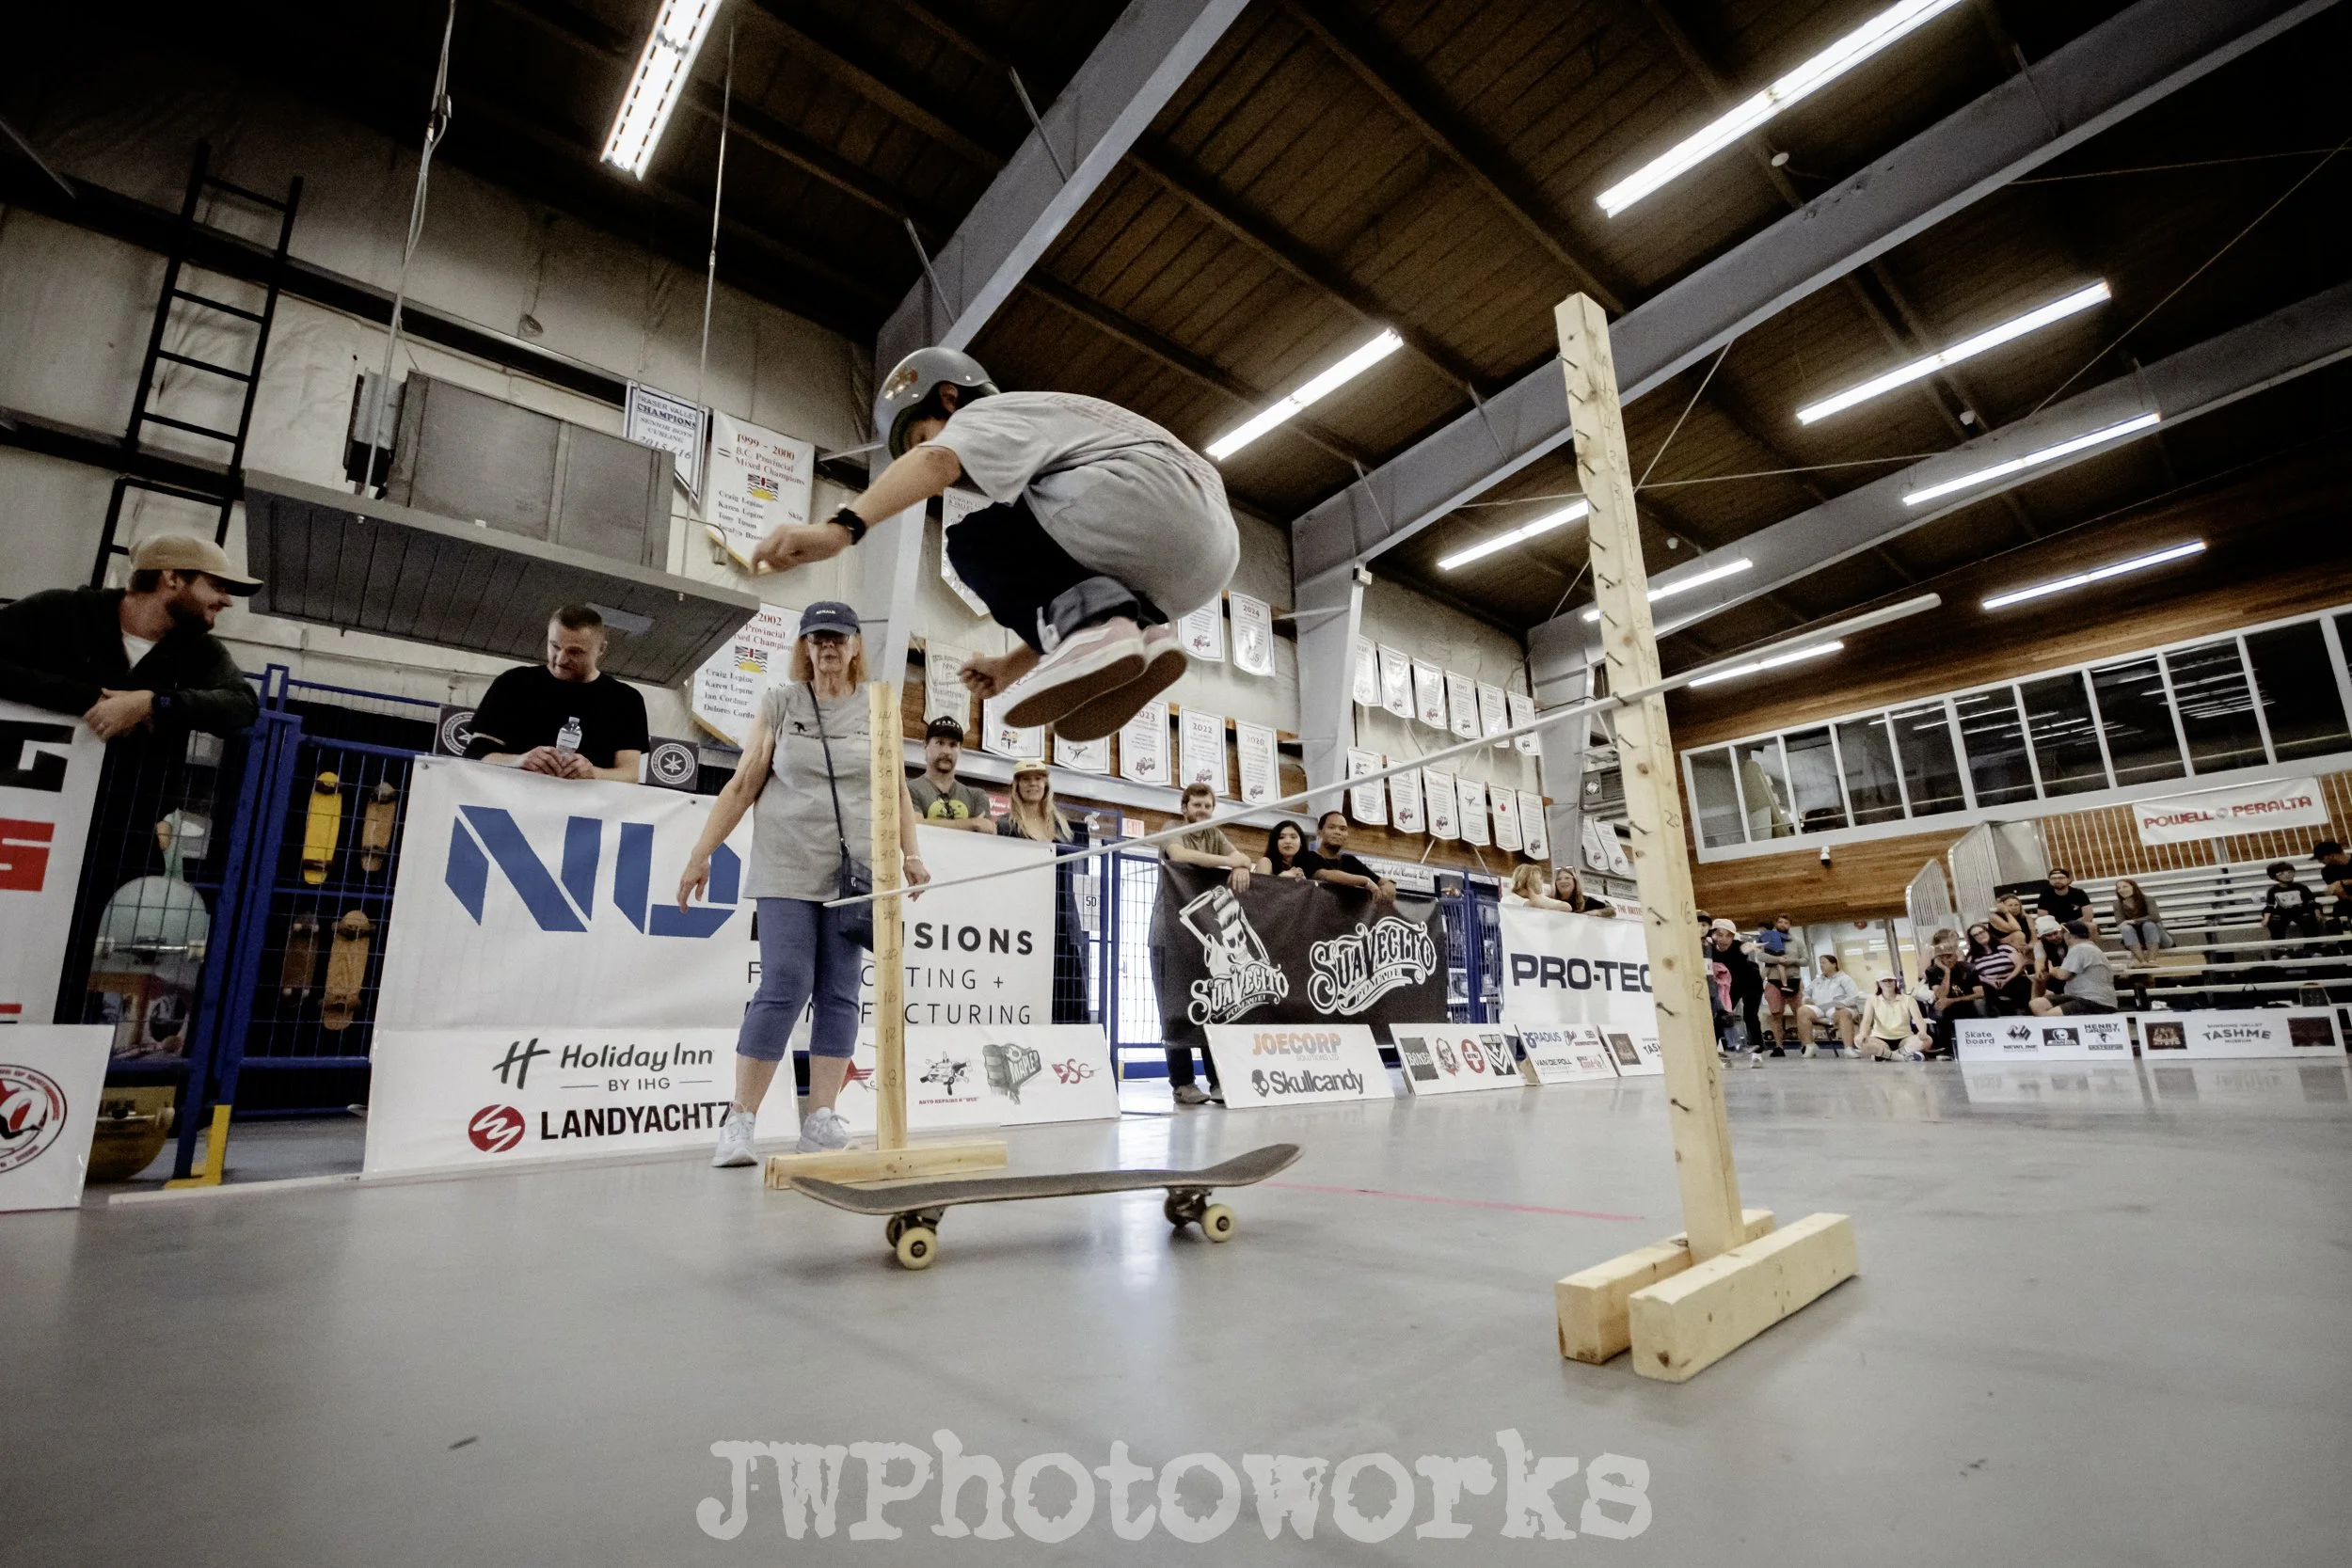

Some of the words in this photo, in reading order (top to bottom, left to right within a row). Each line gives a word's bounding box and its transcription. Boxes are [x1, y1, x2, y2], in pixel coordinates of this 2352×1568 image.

[637, 403, 697, 430] CHAMPIONS
[737, 434, 759, 448] 1999
[772, 445, 795, 461] 2000
[755, 452, 794, 473] Provincial
[736, 457, 761, 471] Mixed
[763, 465, 806, 486] Champions
[719, 490, 739, 502] Craig
[718, 500, 739, 513] Karen
[745, 623, 786, 640] Provincial
[753, 635, 793, 651] Champion
[706, 668, 727, 679] Craig
[705, 679, 728, 690] Karen
[733, 708, 755, 720] Cordn
[1192, 722, 1213, 734] 2022
[1664, 809, 1680, 829] 20
[2143, 810, 2214, 829] POWELL
[2232, 796, 2312, 817] PERALTA
[1679, 900, 1692, 926] 16
[1534, 1031, 1563, 1043] RADIUS
[1964, 1037, 1995, 1046] board
[2202, 1027, 2272, 1041] TASHME
[1252, 1032, 1342, 1056] JOECORP
[560, 1043, 667, 1072] Holiday
[673, 1042, 713, 1065] Inn
[608, 1079, 629, 1092] BY
[638, 1076, 671, 1090] IHG
[1270, 1068, 1364, 1096] Skullcandy
